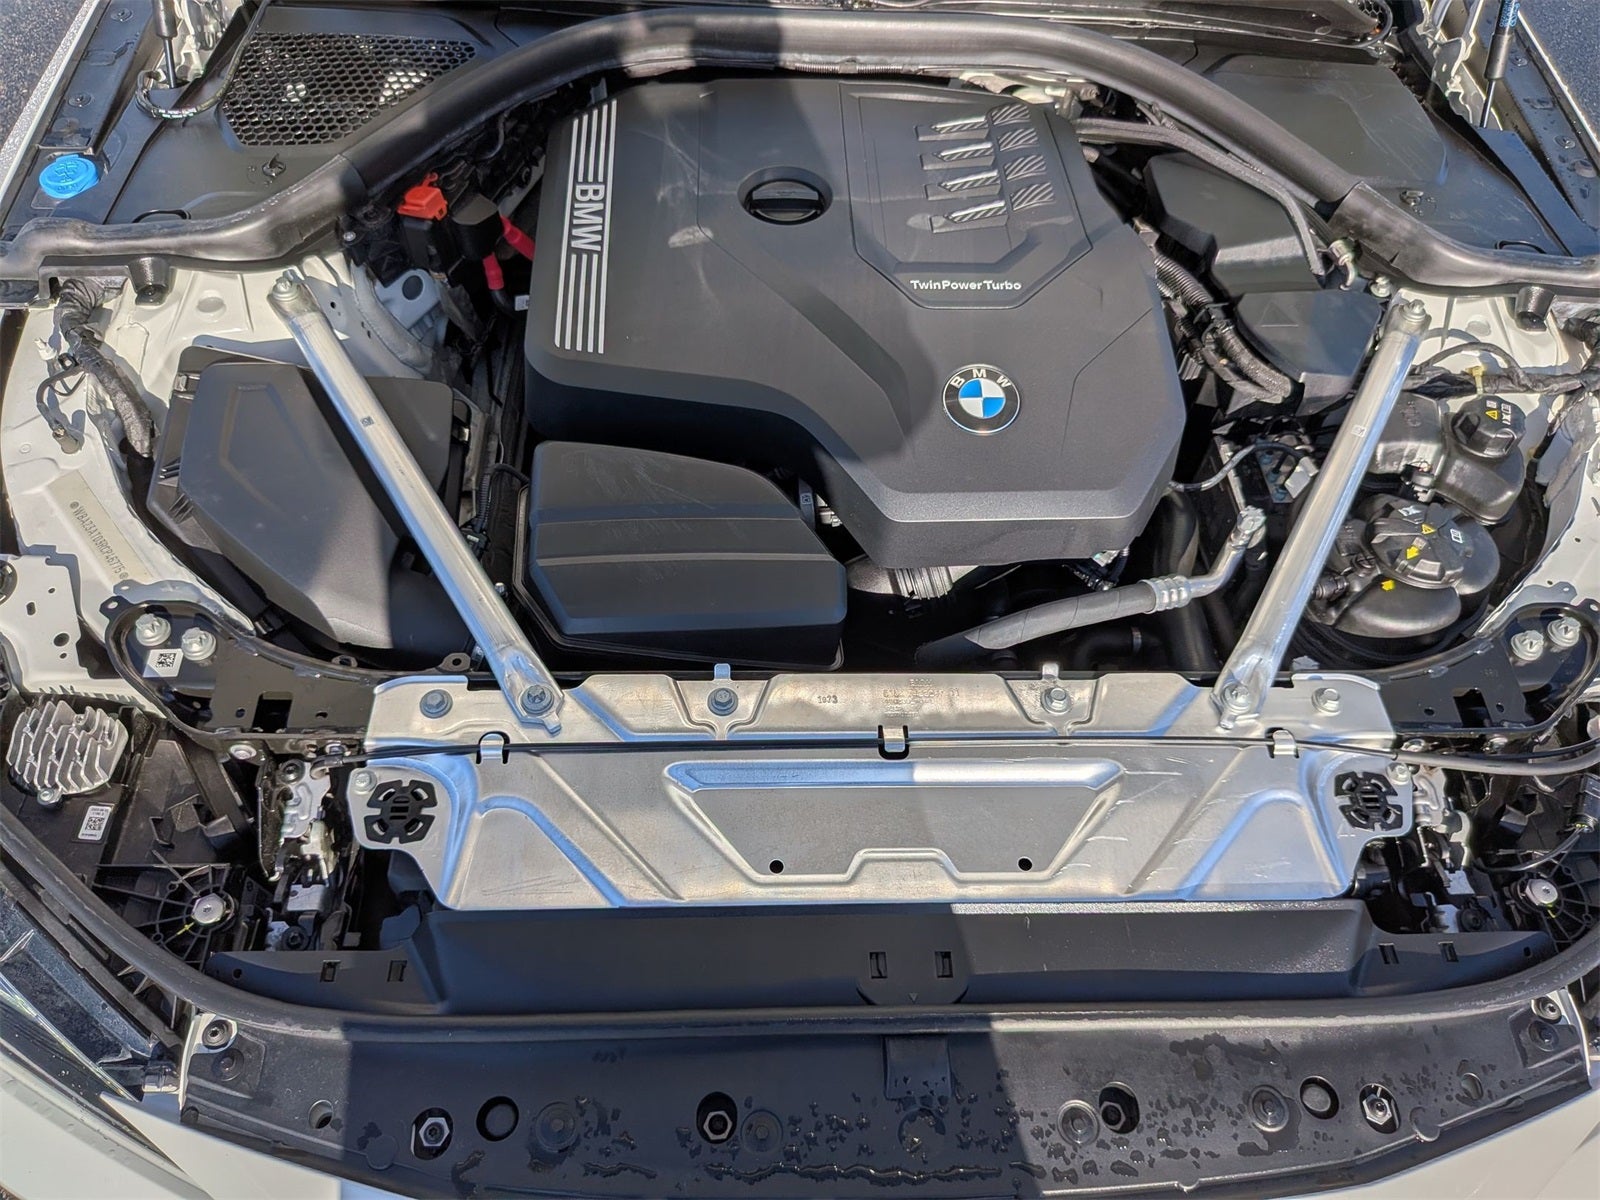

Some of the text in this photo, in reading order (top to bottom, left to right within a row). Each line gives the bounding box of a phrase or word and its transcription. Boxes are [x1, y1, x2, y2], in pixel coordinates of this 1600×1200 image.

[571, 184, 605, 251] BMW
[983, 279, 1022, 290] Turbo
[950, 368, 1011, 388] BMW
